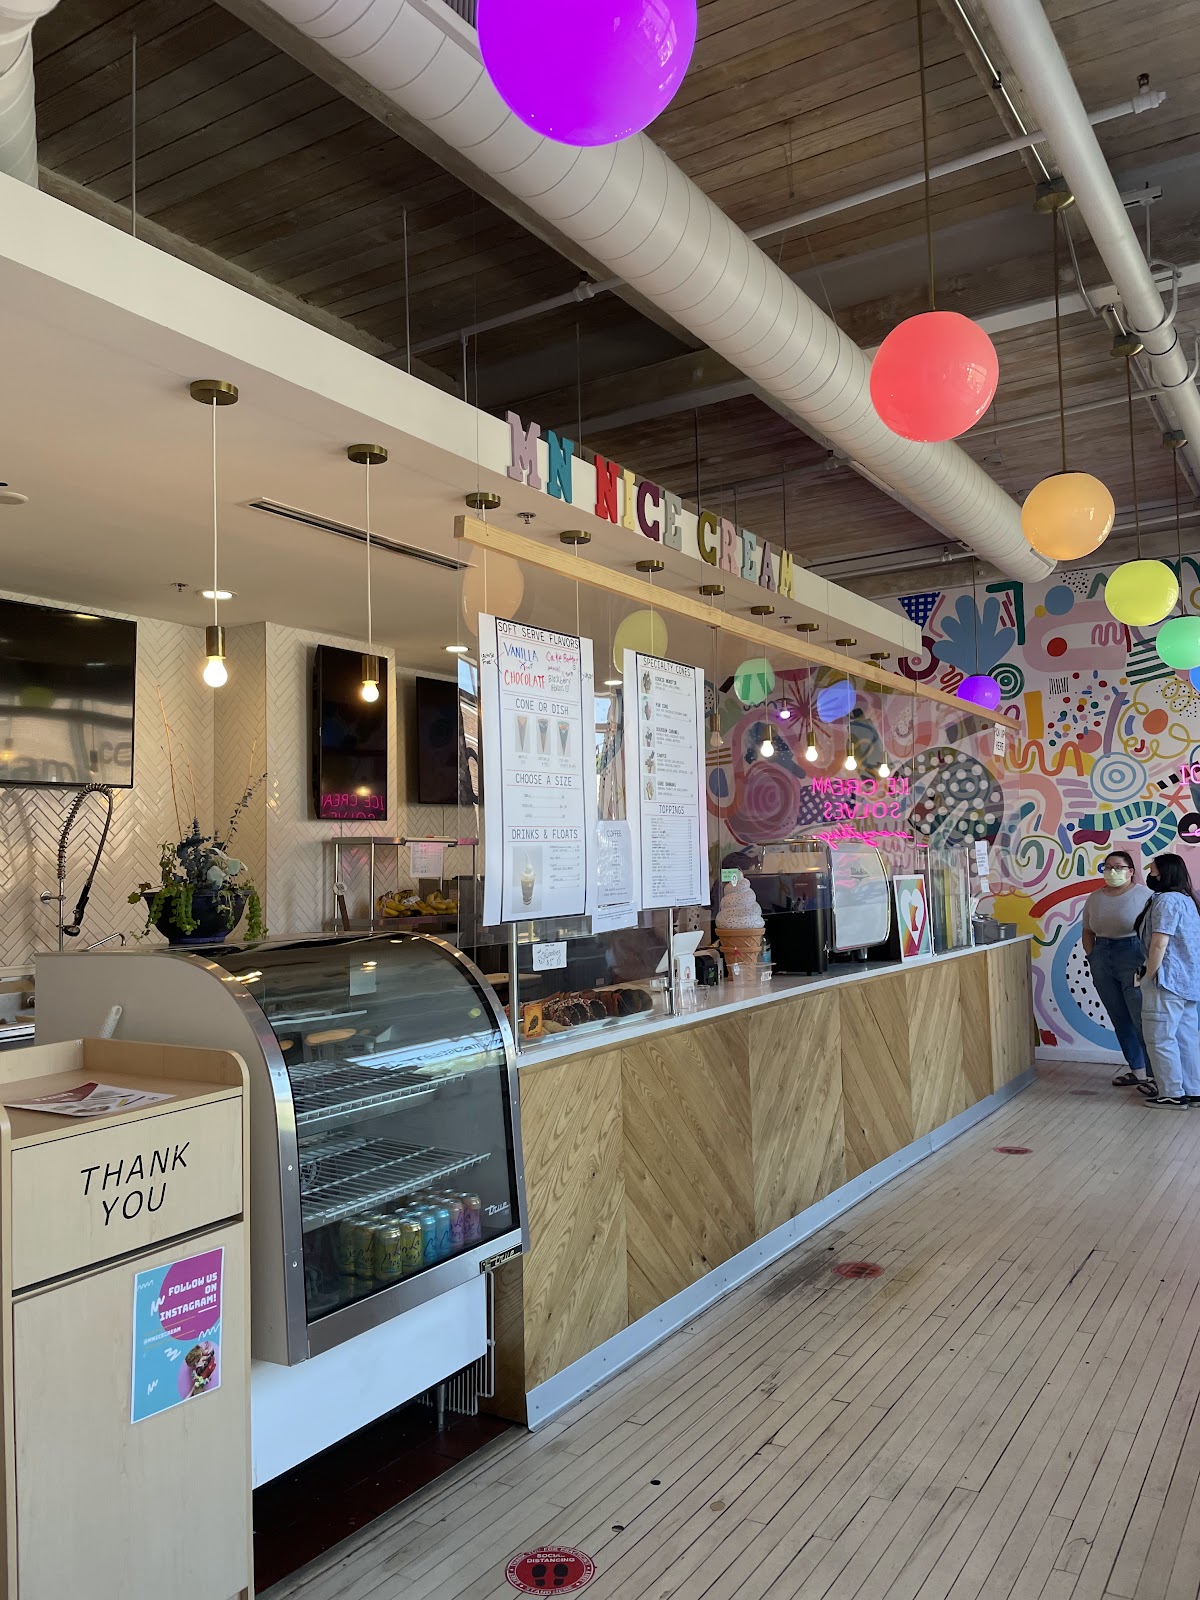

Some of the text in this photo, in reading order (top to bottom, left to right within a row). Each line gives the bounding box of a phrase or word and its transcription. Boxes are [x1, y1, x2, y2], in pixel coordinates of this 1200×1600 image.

[506, 410, 795, 599] MN NICE CREAM
[498, 621, 579, 649] SOFT SERVE FLAVORS
[503, 641, 539, 662] VANILLA
[643, 657, 691, 677] SPECIALTY CONES
[504, 669, 545, 689] CHOCOLATE
[515, 698, 569, 716] CONE OR DISH
[515, 773, 572, 787] CHOOSE A SIZE
[658, 804, 685, 815] TOPPINGS
[511, 828, 578, 840] DRINKS & FLOATS
[606, 829, 622, 838] COFFEE
[81, 1141, 190, 1196] THANK
[102, 1182, 167, 1226] YOU
[168, 1272, 218, 1297] FOLLOW US
[205, 1283, 217, 1295] ON
[160, 1293, 217, 1322] INSTAGRAM!
